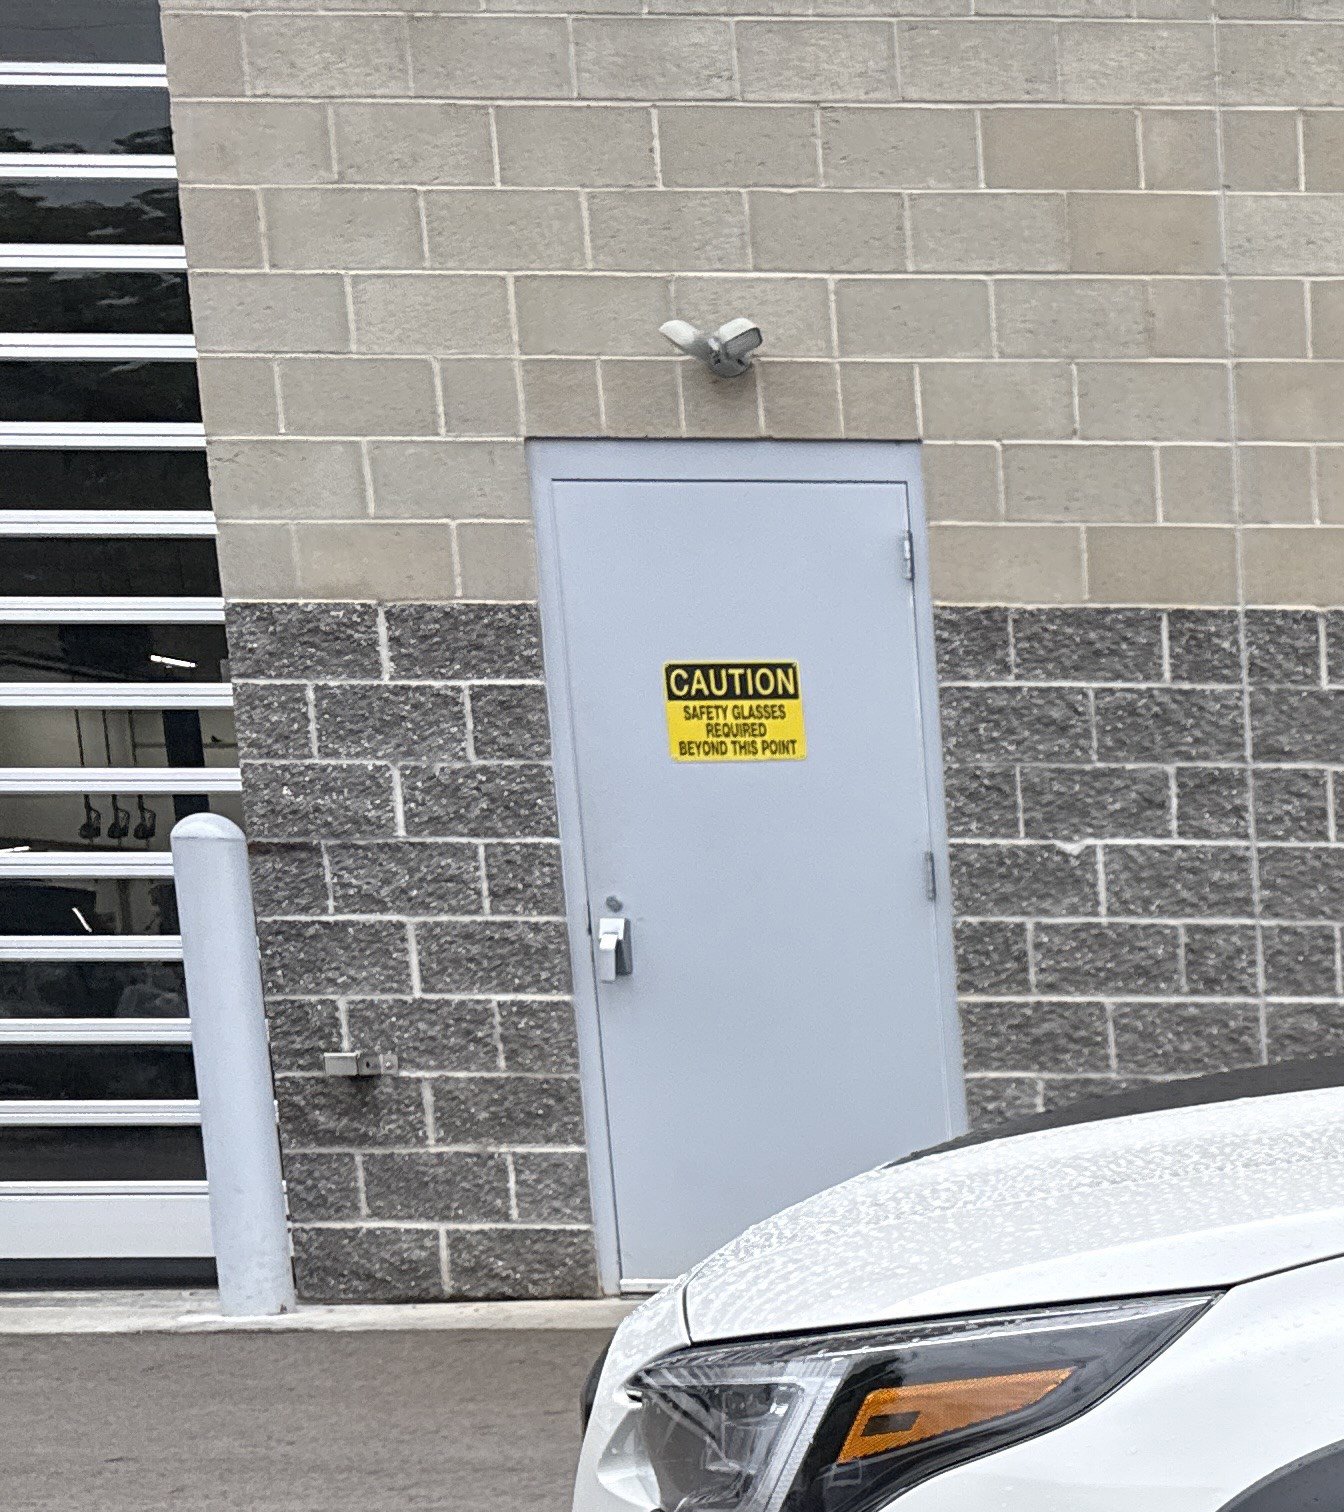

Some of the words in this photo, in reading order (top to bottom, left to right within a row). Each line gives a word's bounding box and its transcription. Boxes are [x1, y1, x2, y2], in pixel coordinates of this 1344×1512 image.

[670, 667, 796, 697] CAUTION
[684, 705, 728, 721] SAFETY
[732, 704, 787, 720] GLASSES
[706, 722, 768, 738] REQUIRED
[679, 740, 728, 756] BEYOND
[731, 740, 759, 756] THIS
[762, 739, 798, 755] POINT
